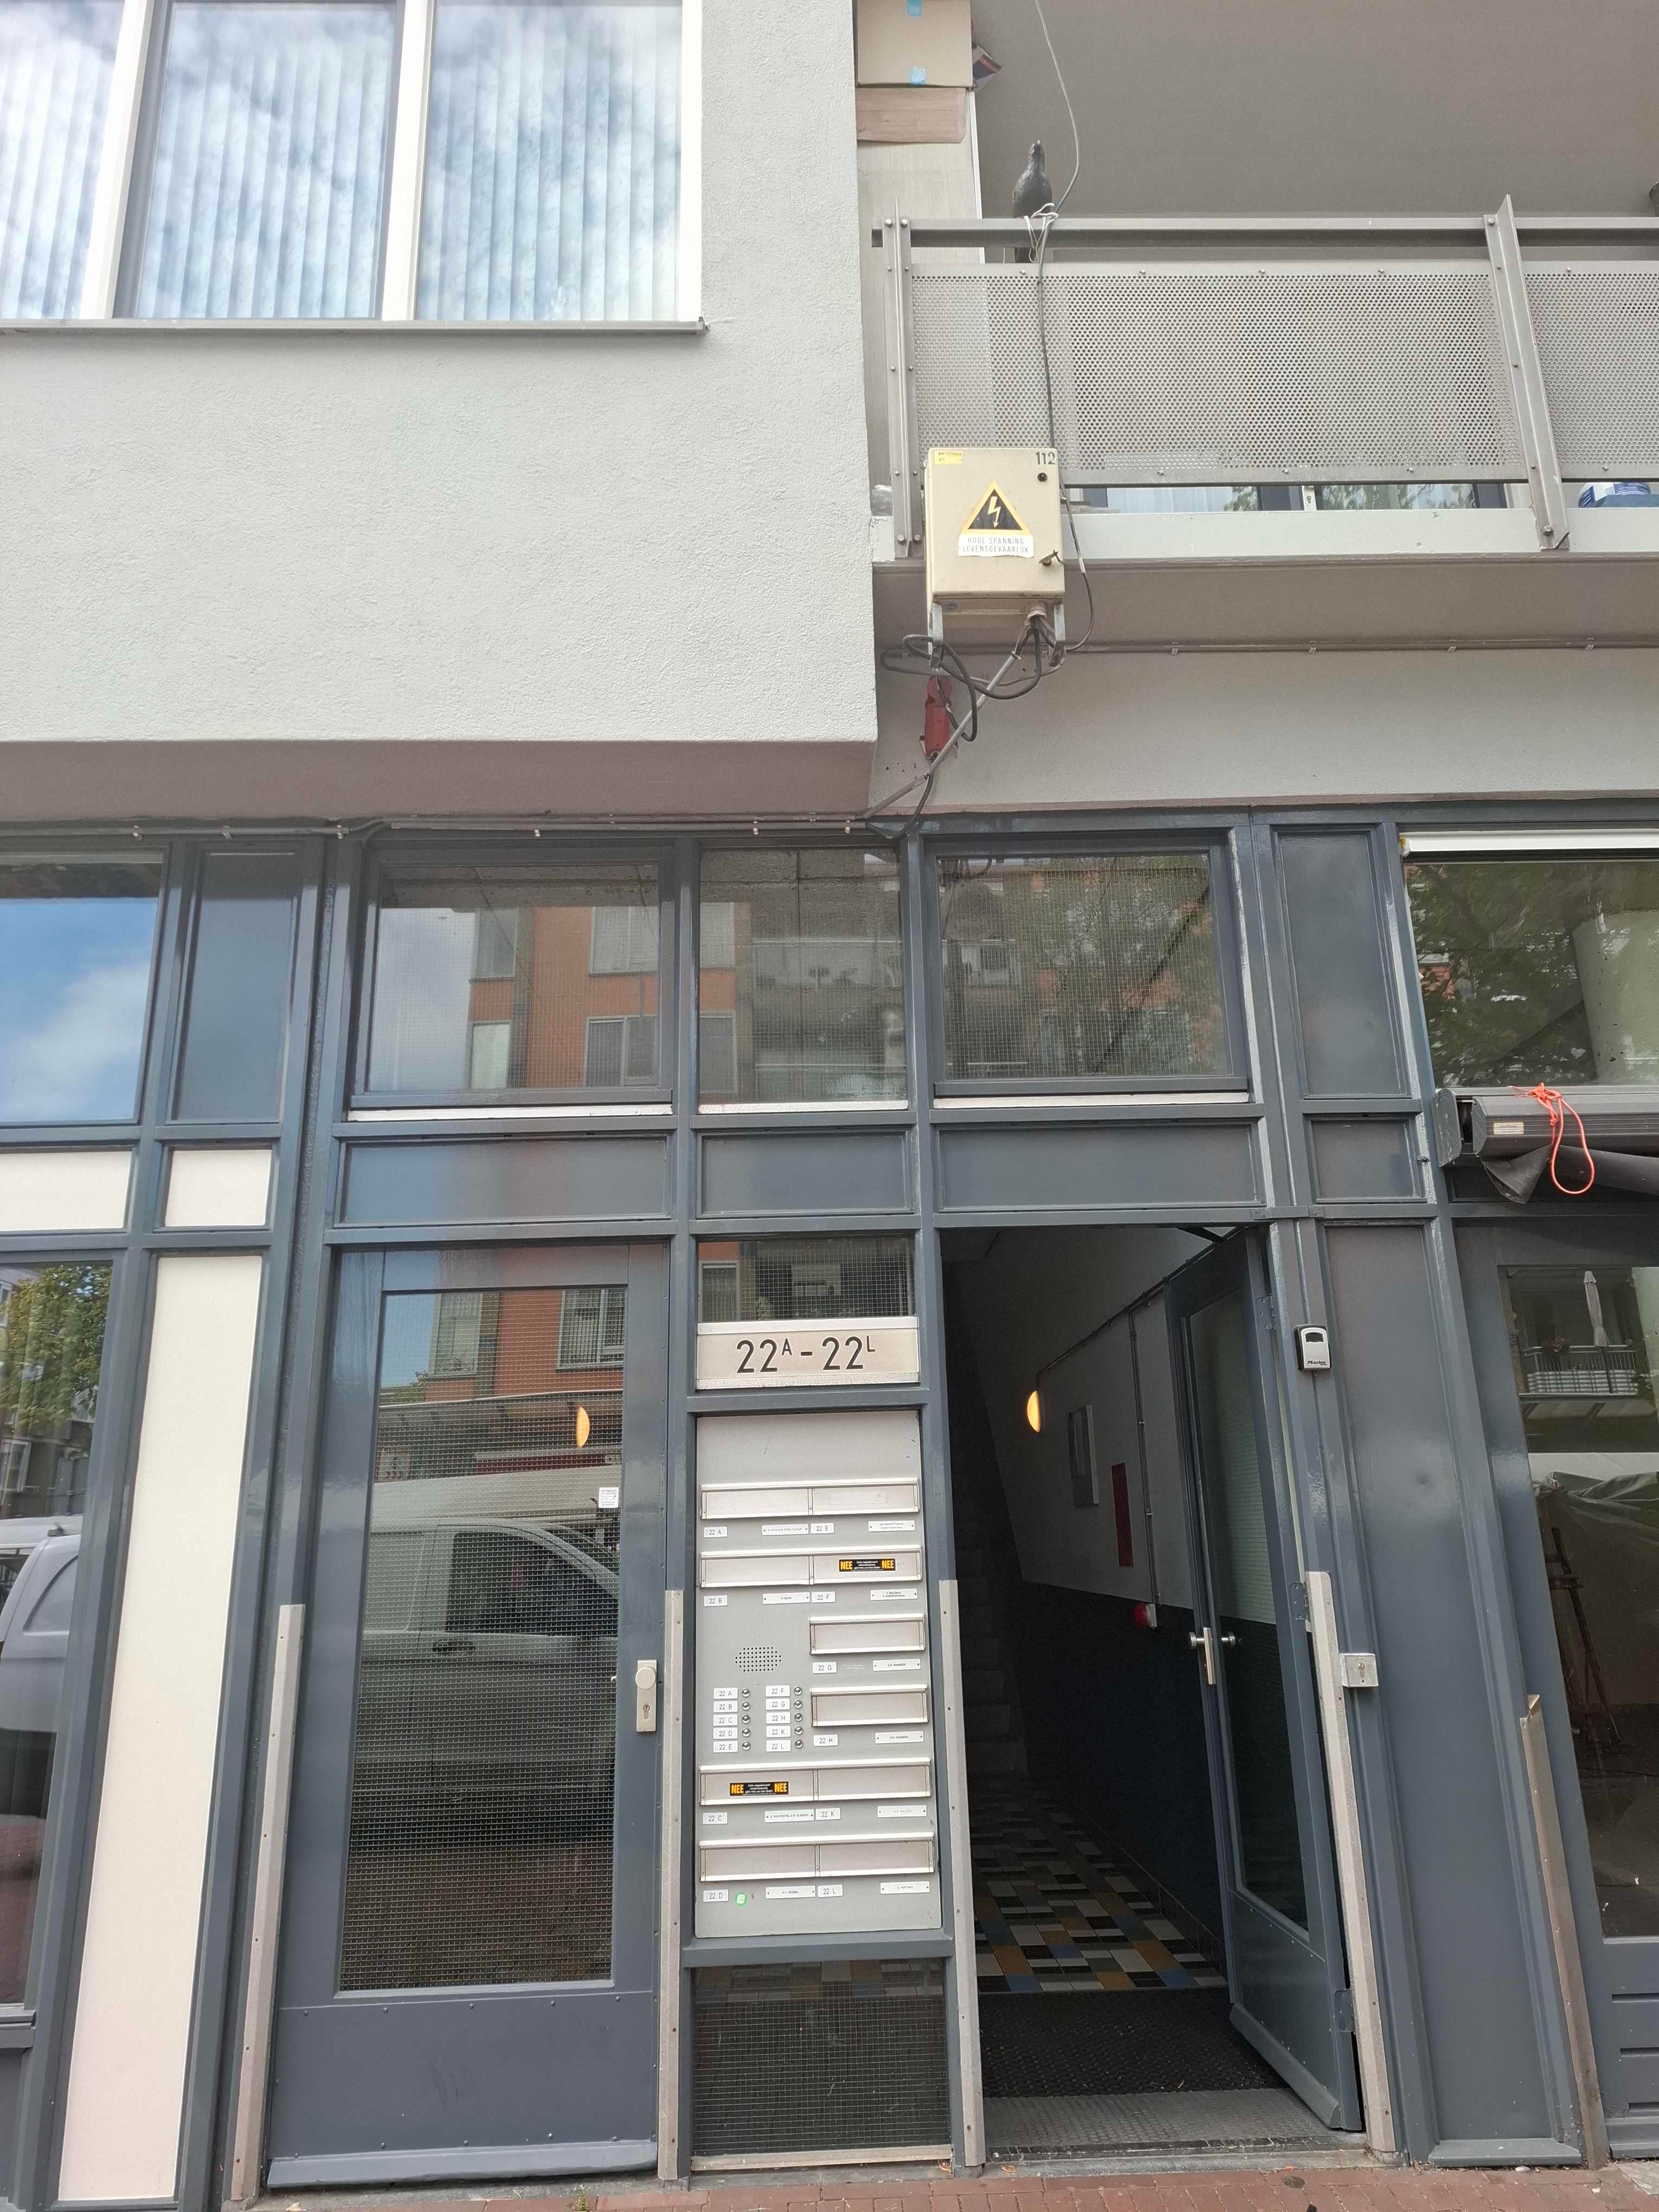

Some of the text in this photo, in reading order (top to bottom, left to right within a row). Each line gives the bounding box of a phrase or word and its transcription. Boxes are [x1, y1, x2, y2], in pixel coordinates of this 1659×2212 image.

[1035, 452, 1056, 465] 112
[840, 1561, 853, 1570] NEE
[882, 1560, 894, 1569] NEE
[731, 1784, 744, 1794] NEE
[774, 1783, 787, 1792] NEE
